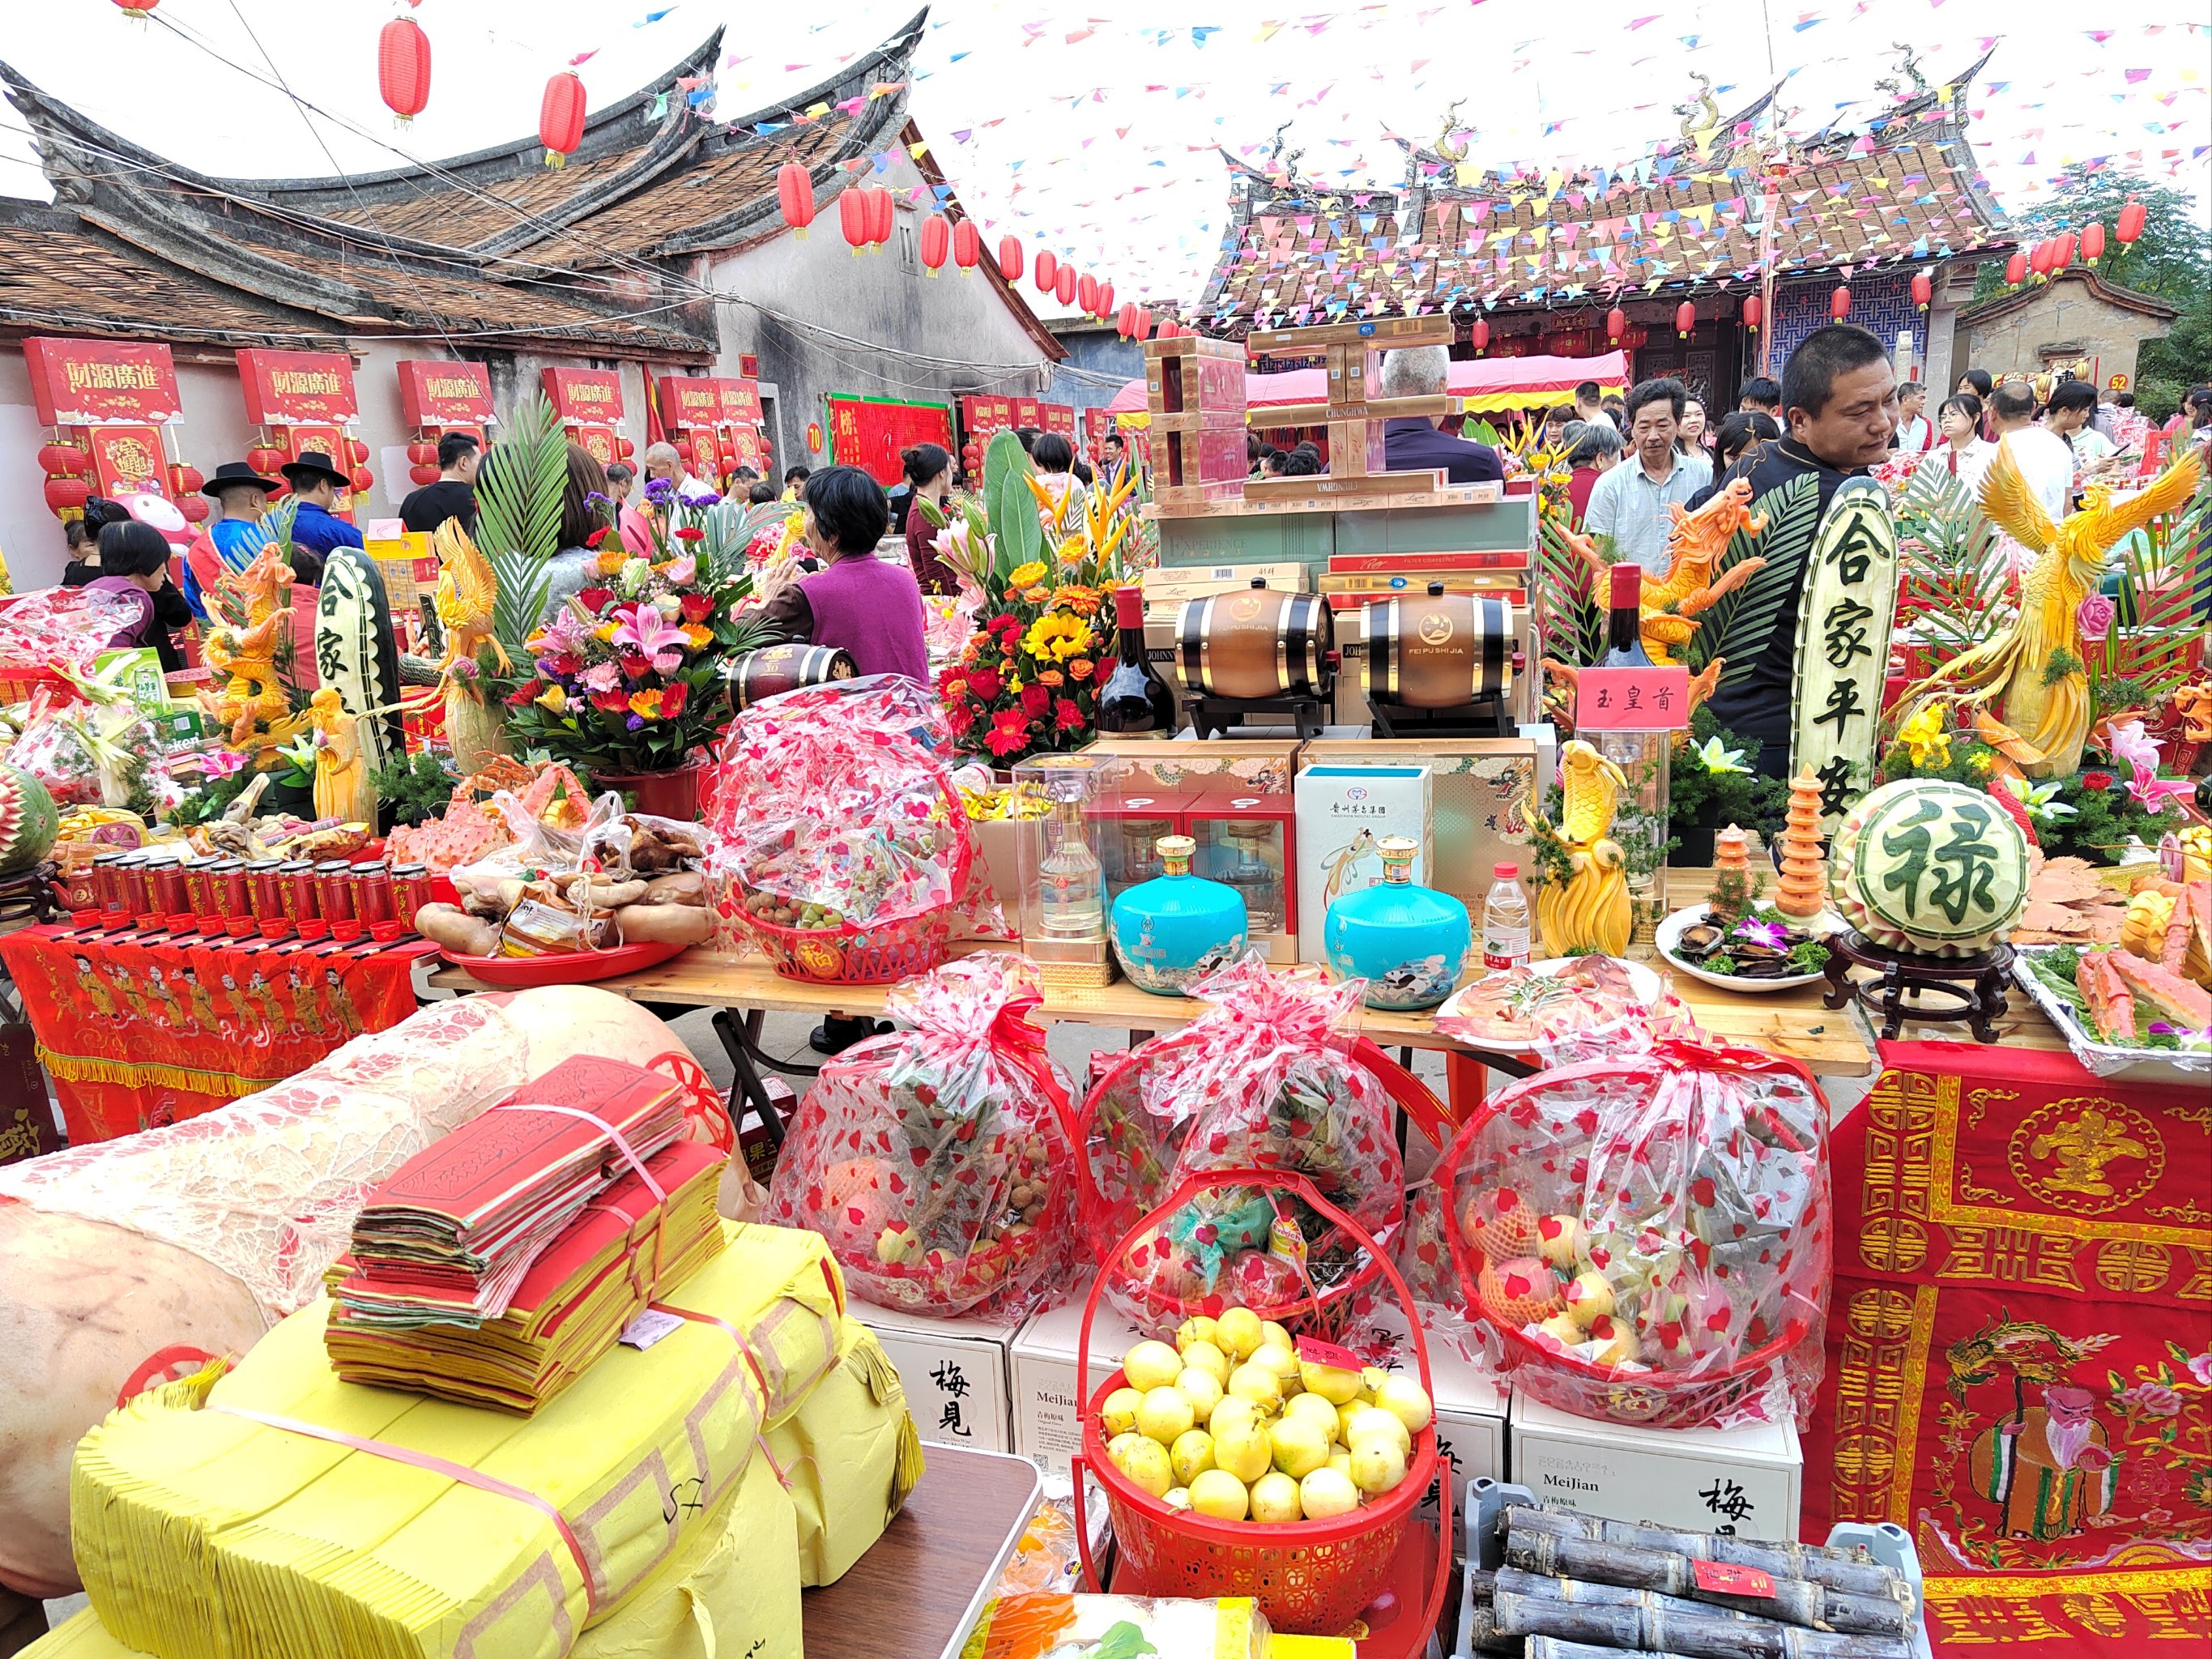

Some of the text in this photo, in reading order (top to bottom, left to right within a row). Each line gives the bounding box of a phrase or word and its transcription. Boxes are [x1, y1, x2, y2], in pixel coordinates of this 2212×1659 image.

[66, 362, 161, 394] 財源廣進
[272, 370, 343, 399] 財源廣進
[2111, 375, 2126, 390] 52
[1326, 406, 1369, 419] CHUNGHWA
[809, 429, 820, 449] 70
[1316, 480, 1358, 493] CHUNGHWA
[1345, 645, 1361, 655] JOH
[1813, 513, 1890, 817] 合家平安
[1597, 685, 1675, 712] 玉皇首
[166, 731, 200, 753] eken
[800, 943, 833, 968] 福
[1273, 1224, 1301, 1241] Everich
[1543, 1473, 1600, 1491] MeiJian
